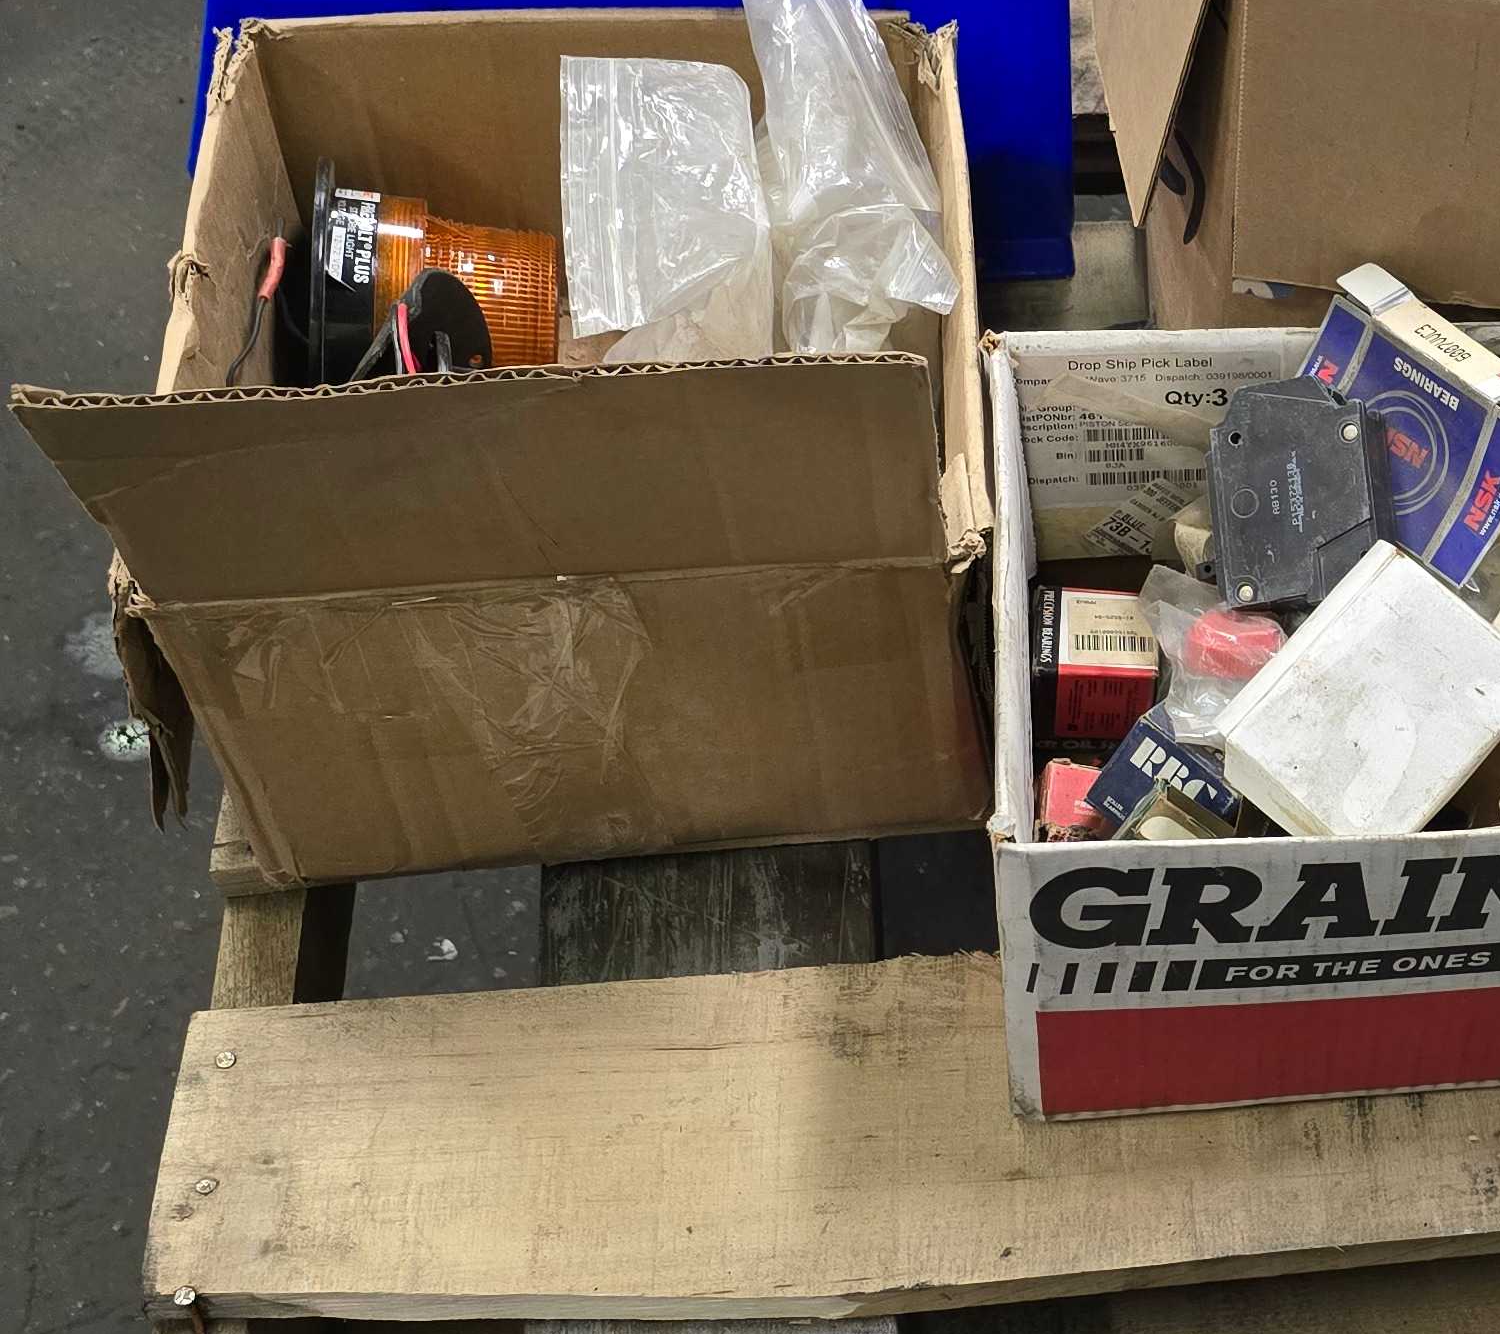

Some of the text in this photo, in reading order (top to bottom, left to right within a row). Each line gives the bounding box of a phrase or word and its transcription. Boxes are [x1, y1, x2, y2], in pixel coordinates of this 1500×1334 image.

[344, 233, 356, 260] LIGHT
[352, 249, 372, 284] PLUS
[1068, 357, 1213, 373] Drop Ship Pick Label
[1155, 373, 1202, 383] Dispatch:
[1394, 355, 1460, 412] BEARINGS
[1046, 434, 1079, 443] Code:
[1130, 736, 1218, 801] RBC
[1224, 963, 1300, 982] FOR
[1312, 958, 1382, 977] THE
[1392, 950, 1492, 972] ONES
